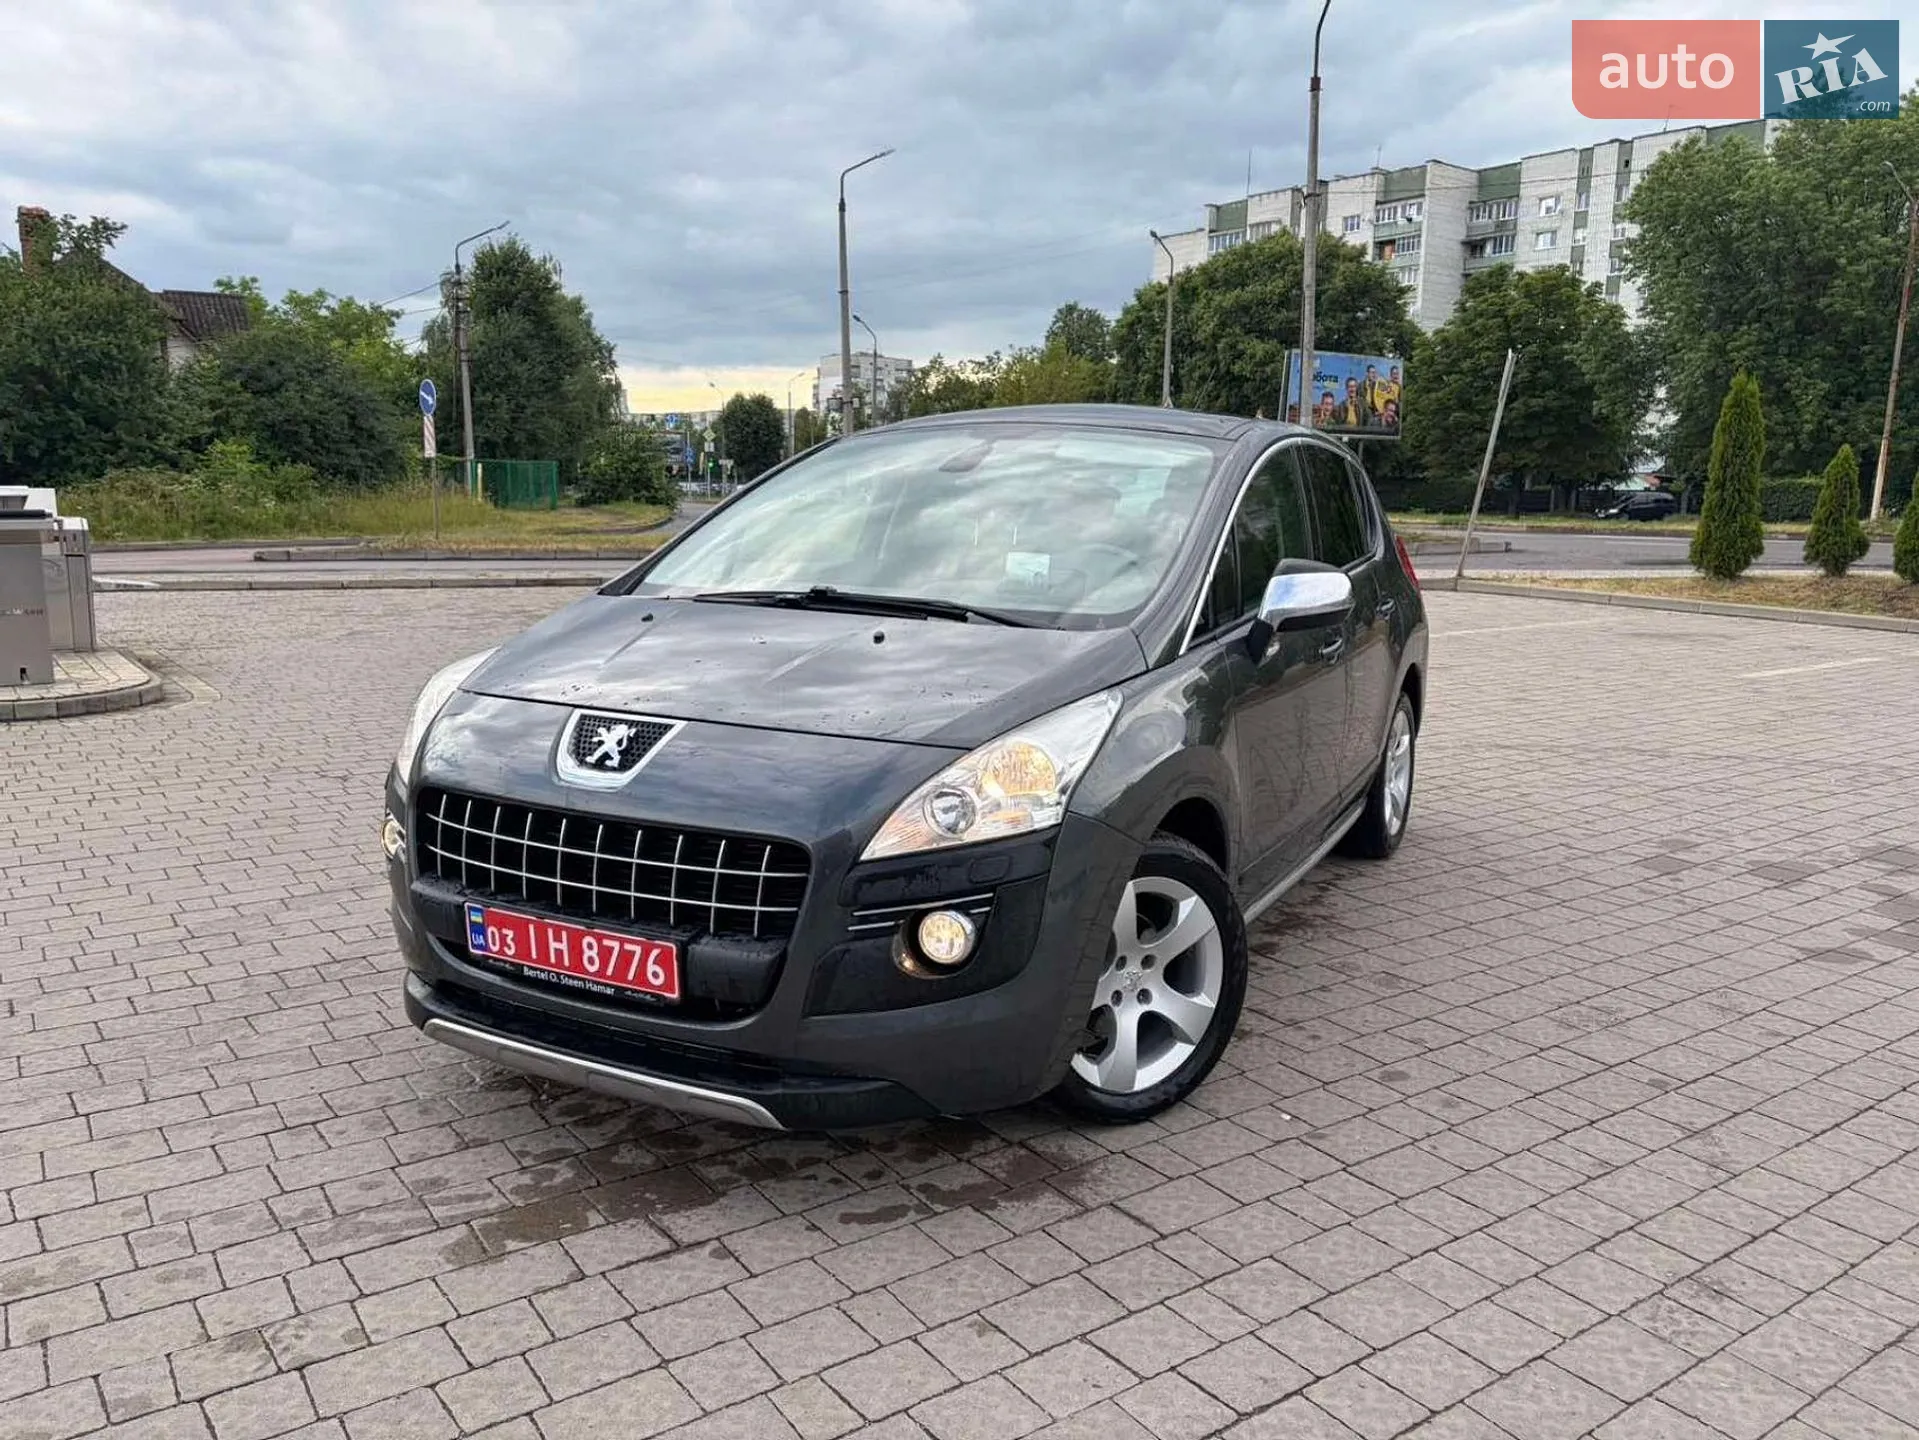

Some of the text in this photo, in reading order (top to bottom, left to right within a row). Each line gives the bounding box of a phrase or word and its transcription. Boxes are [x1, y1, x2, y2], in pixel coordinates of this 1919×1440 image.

[472, 932, 485, 946] UA
[488, 926, 516, 955] 03
[582, 936, 665, 986] 8776
[523, 965, 548, 981] Bertel
[560, 974, 585, 989] Steen
[585, 979, 616, 997] Hamar
